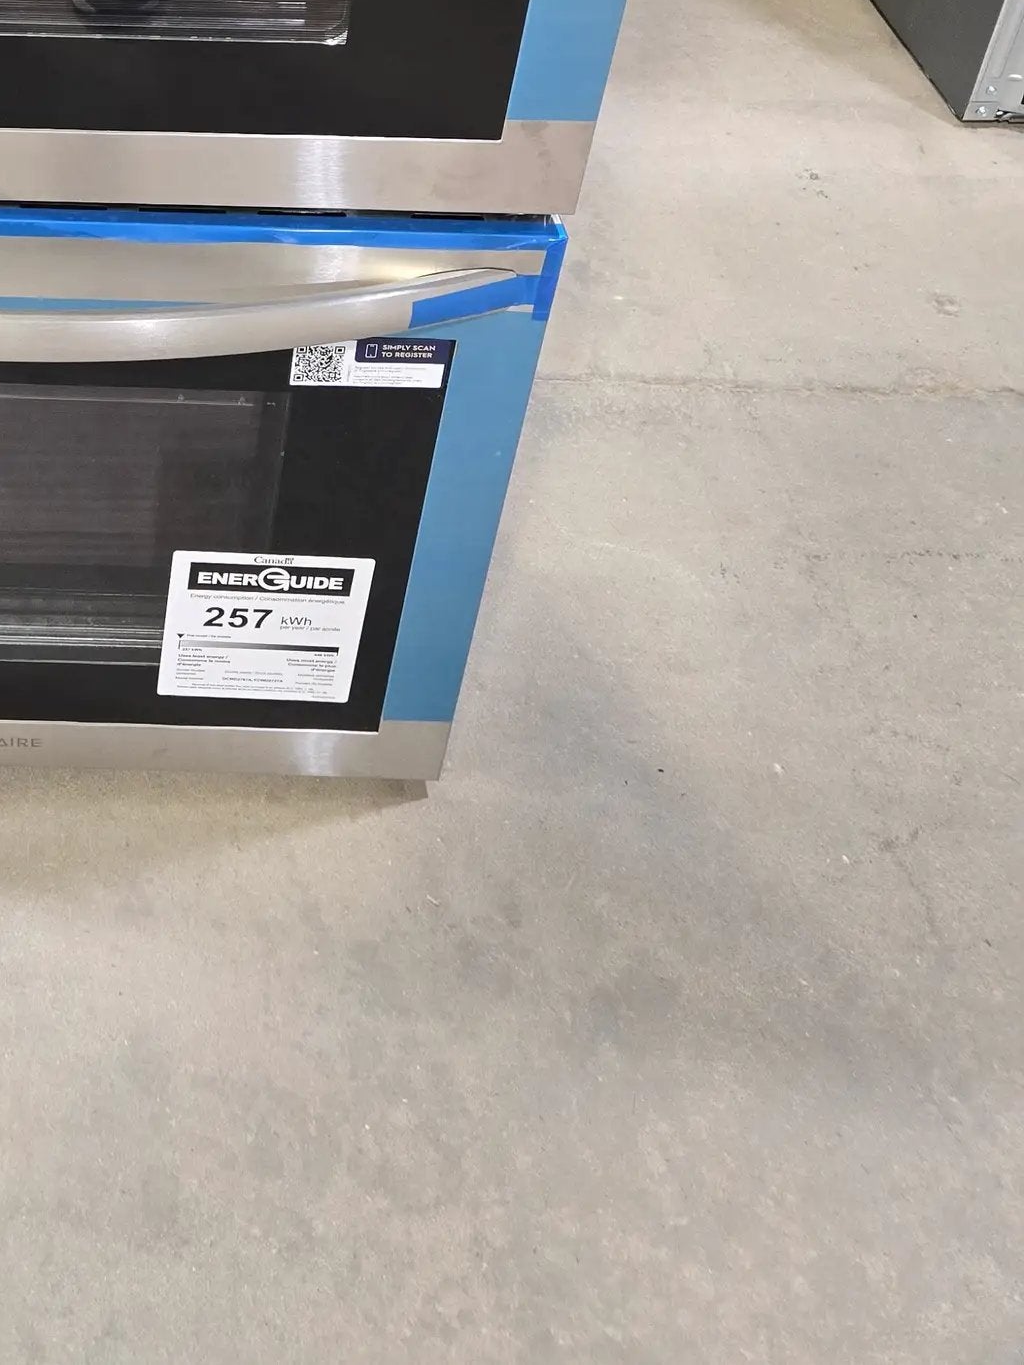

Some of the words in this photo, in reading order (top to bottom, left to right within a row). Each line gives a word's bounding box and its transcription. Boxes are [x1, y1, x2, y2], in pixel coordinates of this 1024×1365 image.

[254, 556, 295, 565] Canada
[197, 567, 344, 591] ENERGUIDE
[203, 607, 273, 628] 257
[281, 616, 312, 626] kWh
